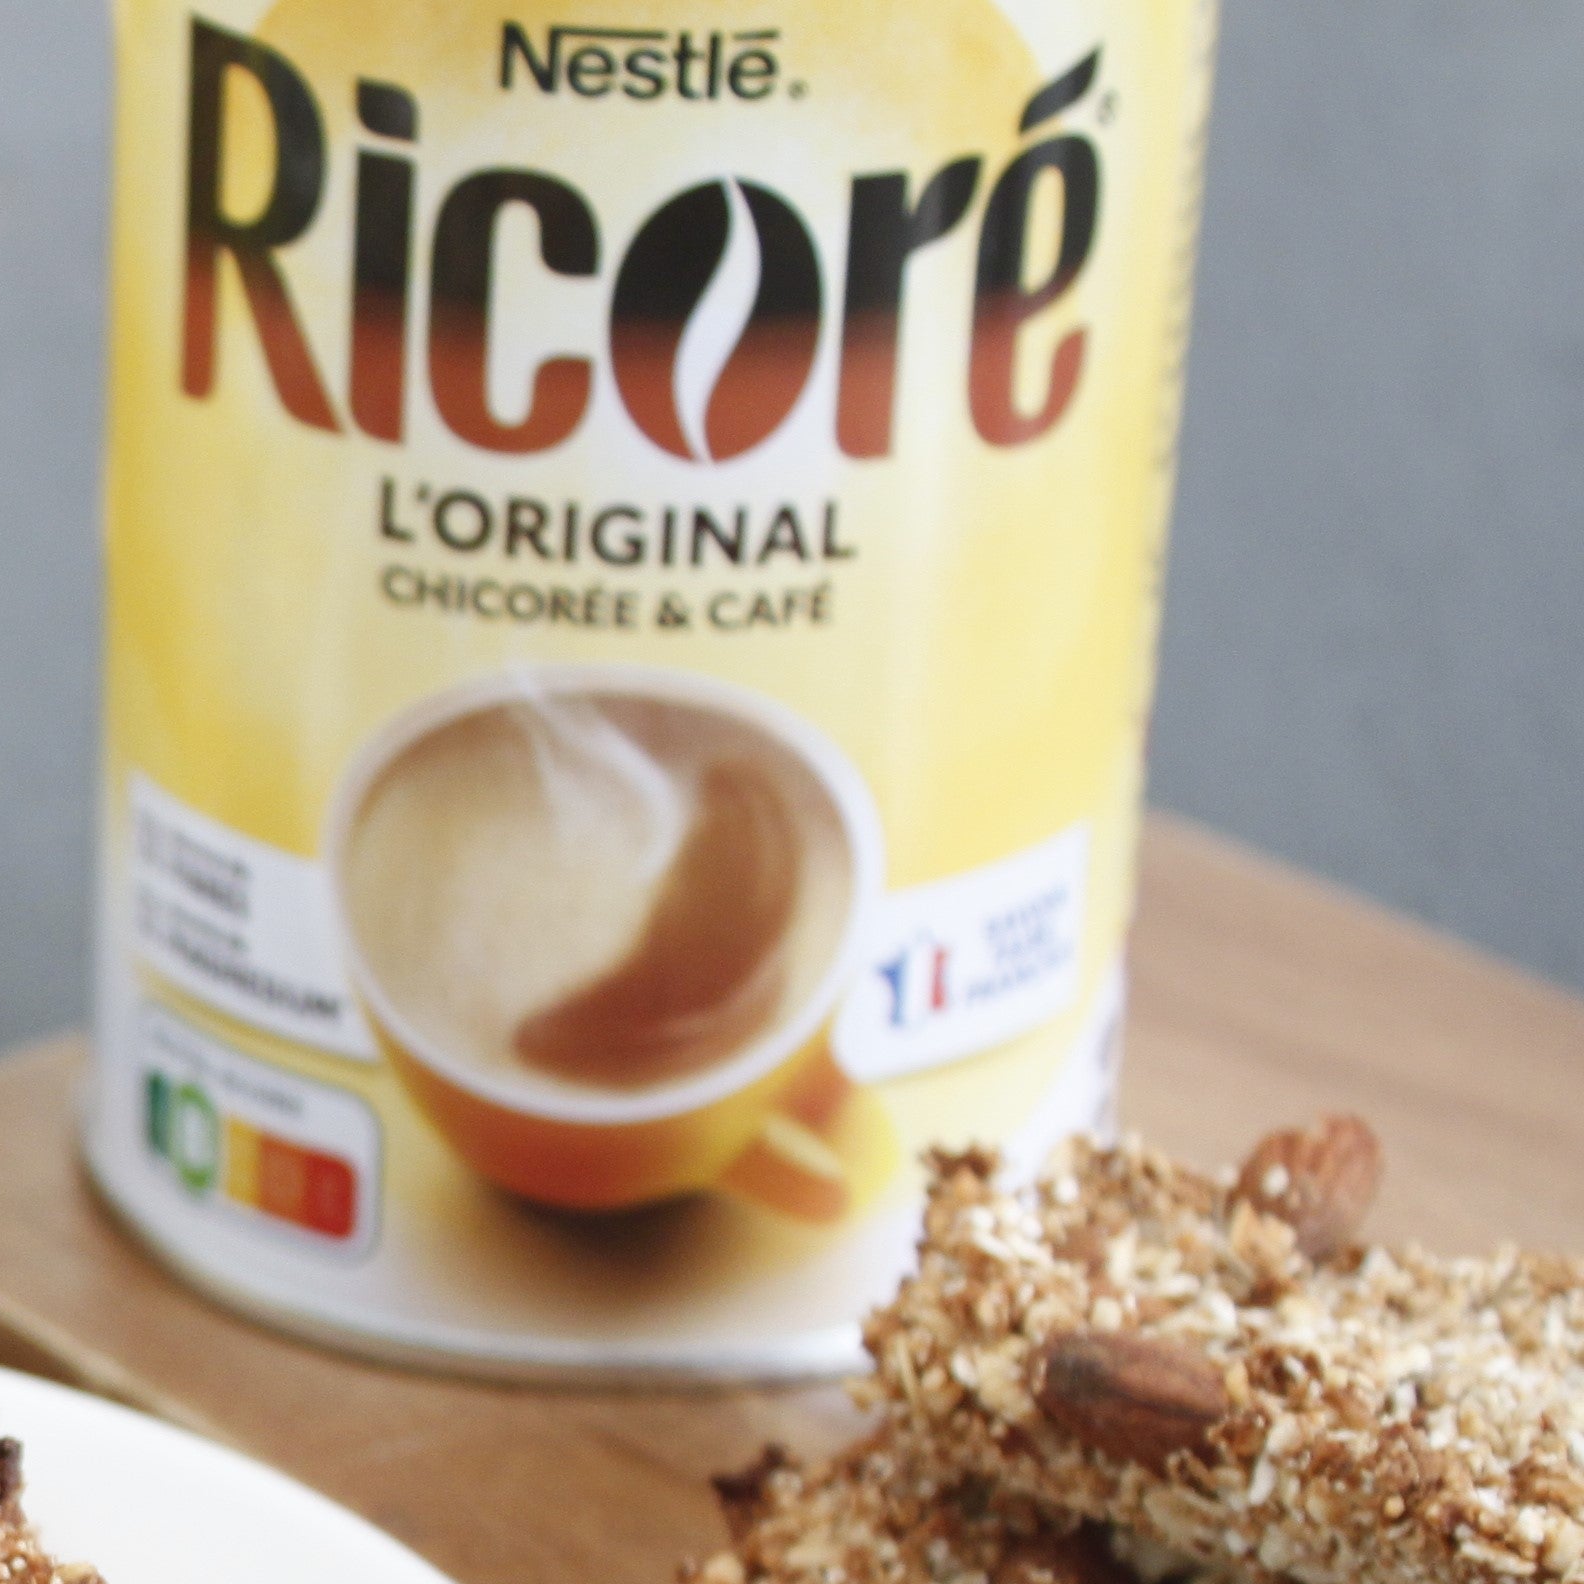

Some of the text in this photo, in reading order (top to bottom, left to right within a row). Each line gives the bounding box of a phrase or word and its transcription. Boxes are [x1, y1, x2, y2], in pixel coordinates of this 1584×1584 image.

[501, 20, 781, 100] Nestlé
[180, 14, 1103, 464] Ricoré
[379, 476, 858, 567] L'ORIGINAL
[381, 564, 834, 631] CHICORÉE & CAFÉ
